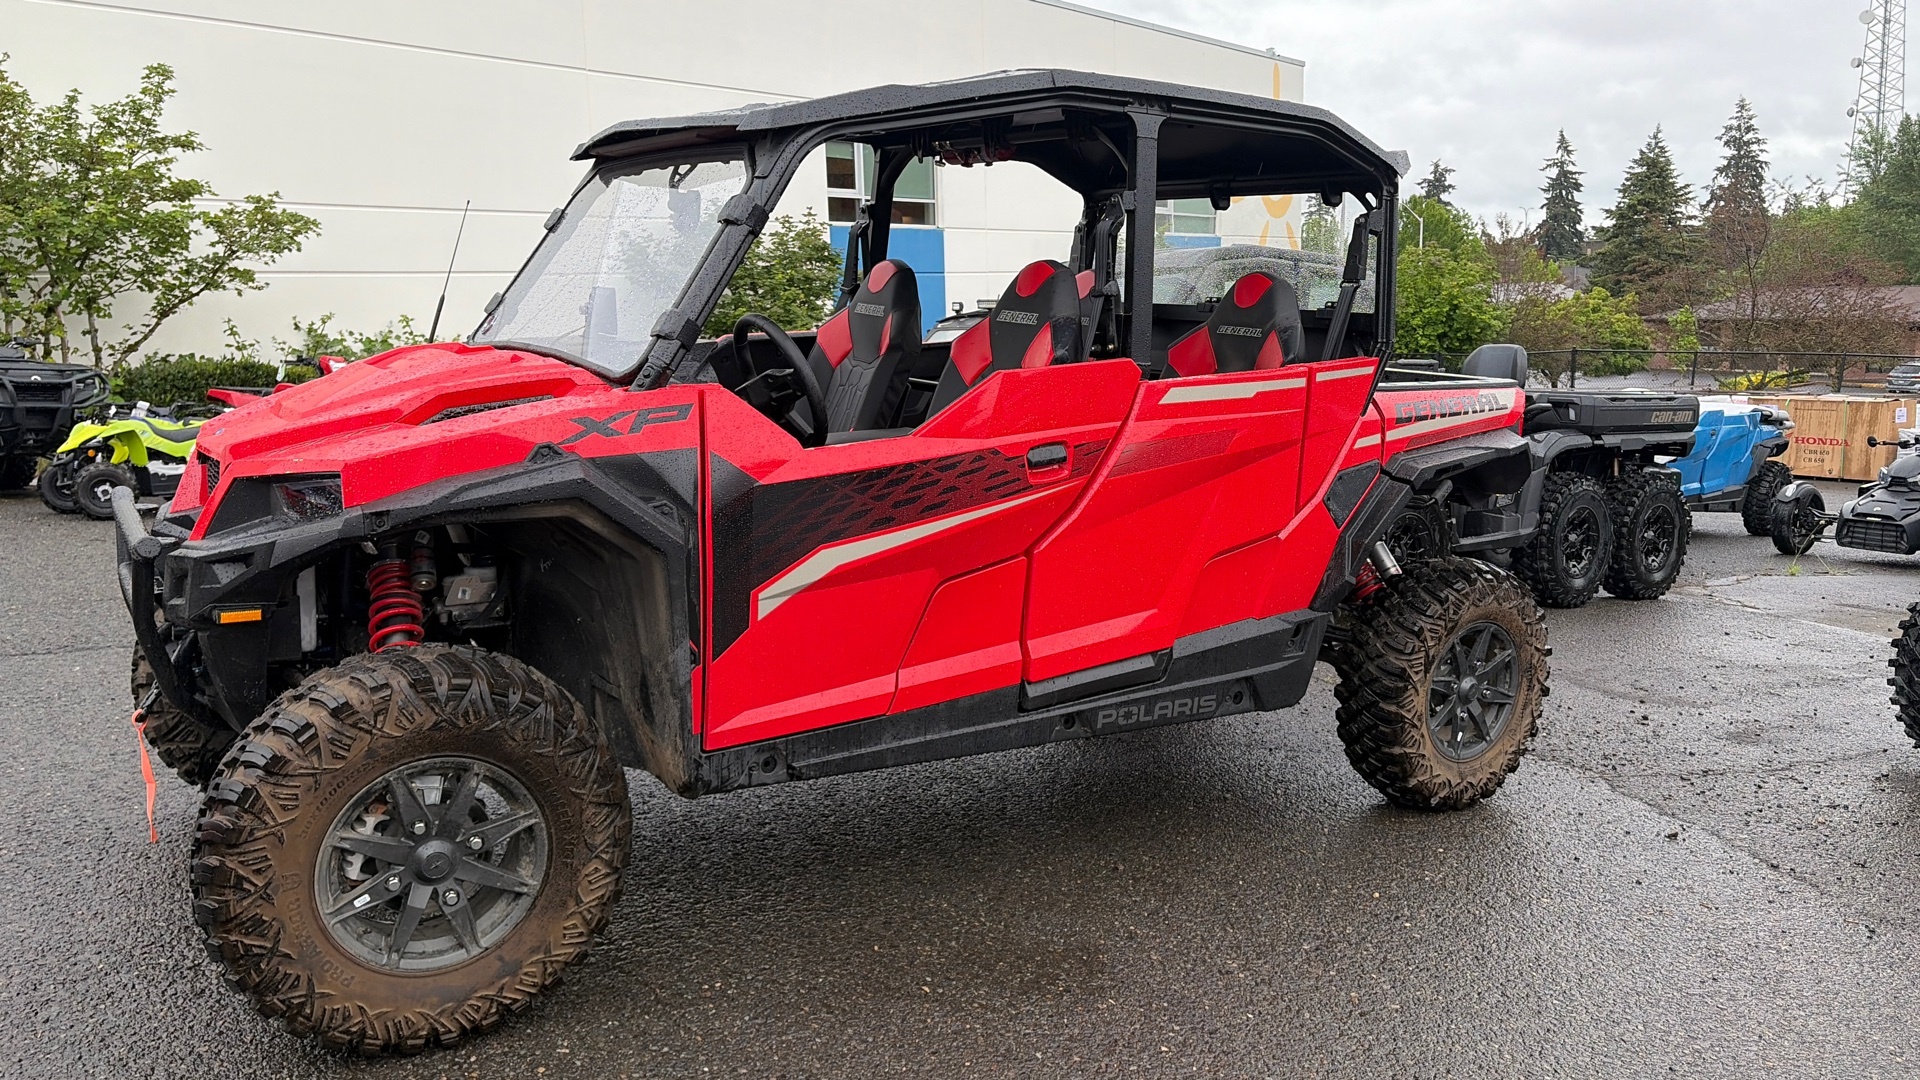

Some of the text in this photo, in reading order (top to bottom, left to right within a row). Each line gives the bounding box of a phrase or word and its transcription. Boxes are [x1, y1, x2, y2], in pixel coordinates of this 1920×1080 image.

[854, 302, 886, 317] GENERAL
[996, 309, 1039, 325] GENERAL
[1216, 324, 1263, 338] GENERAL
[1394, 392, 1509, 425] GENERAL
[1650, 410, 1694, 423] can-am
[555, 403, 695, 446] XP
[1794, 436, 1850, 447] HONDA
[1096, 694, 1217, 729] POLARIS
